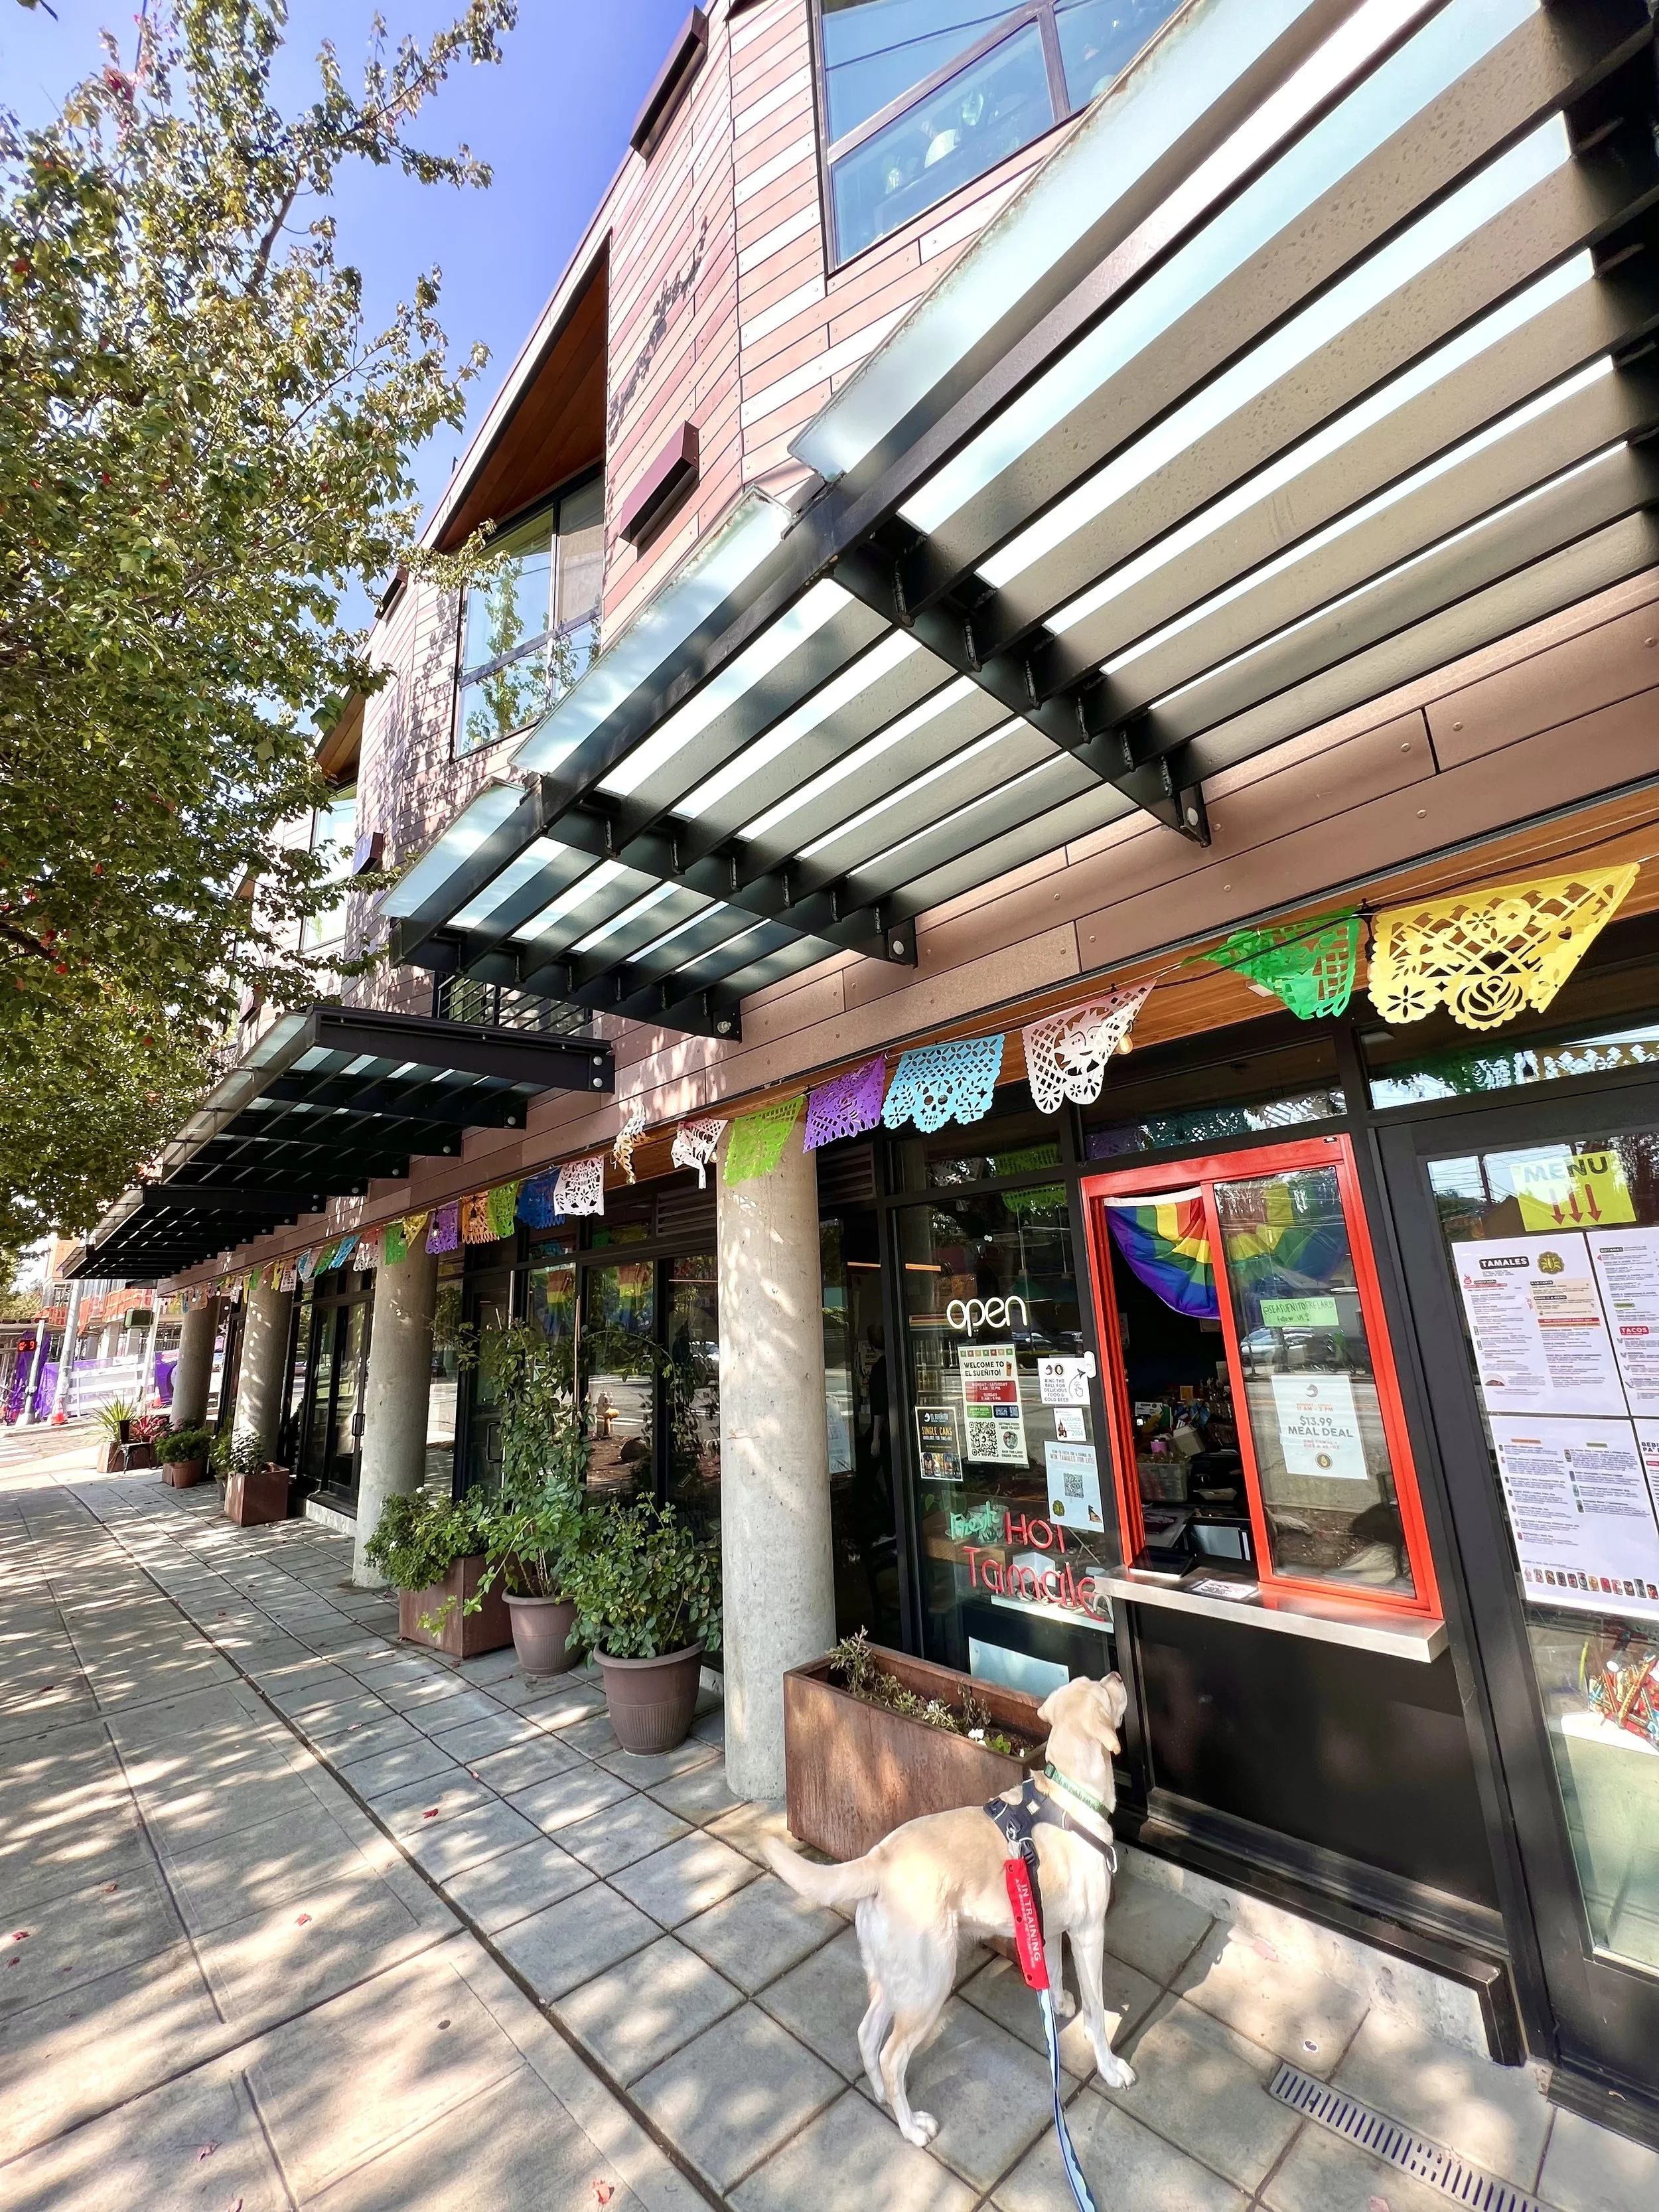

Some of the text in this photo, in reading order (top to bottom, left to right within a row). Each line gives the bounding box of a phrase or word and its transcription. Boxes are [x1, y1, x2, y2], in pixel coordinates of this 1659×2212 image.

[1524, 1156, 1608, 1183] MENU
[1481, 1258, 1528, 1268] TAMALES
[947, 1295, 1027, 1337] open
[29, 1341, 35, 1350] 9
[1299, 1415, 1333, 1426] $13.99
[921, 1426, 953, 1436] SINGLE CANS
[1288, 1426, 1354, 1438] MEAL DEAL
[949, 1500, 999, 1540] Fresh
[1021, 1883, 1042, 1962] IN TRAINING
